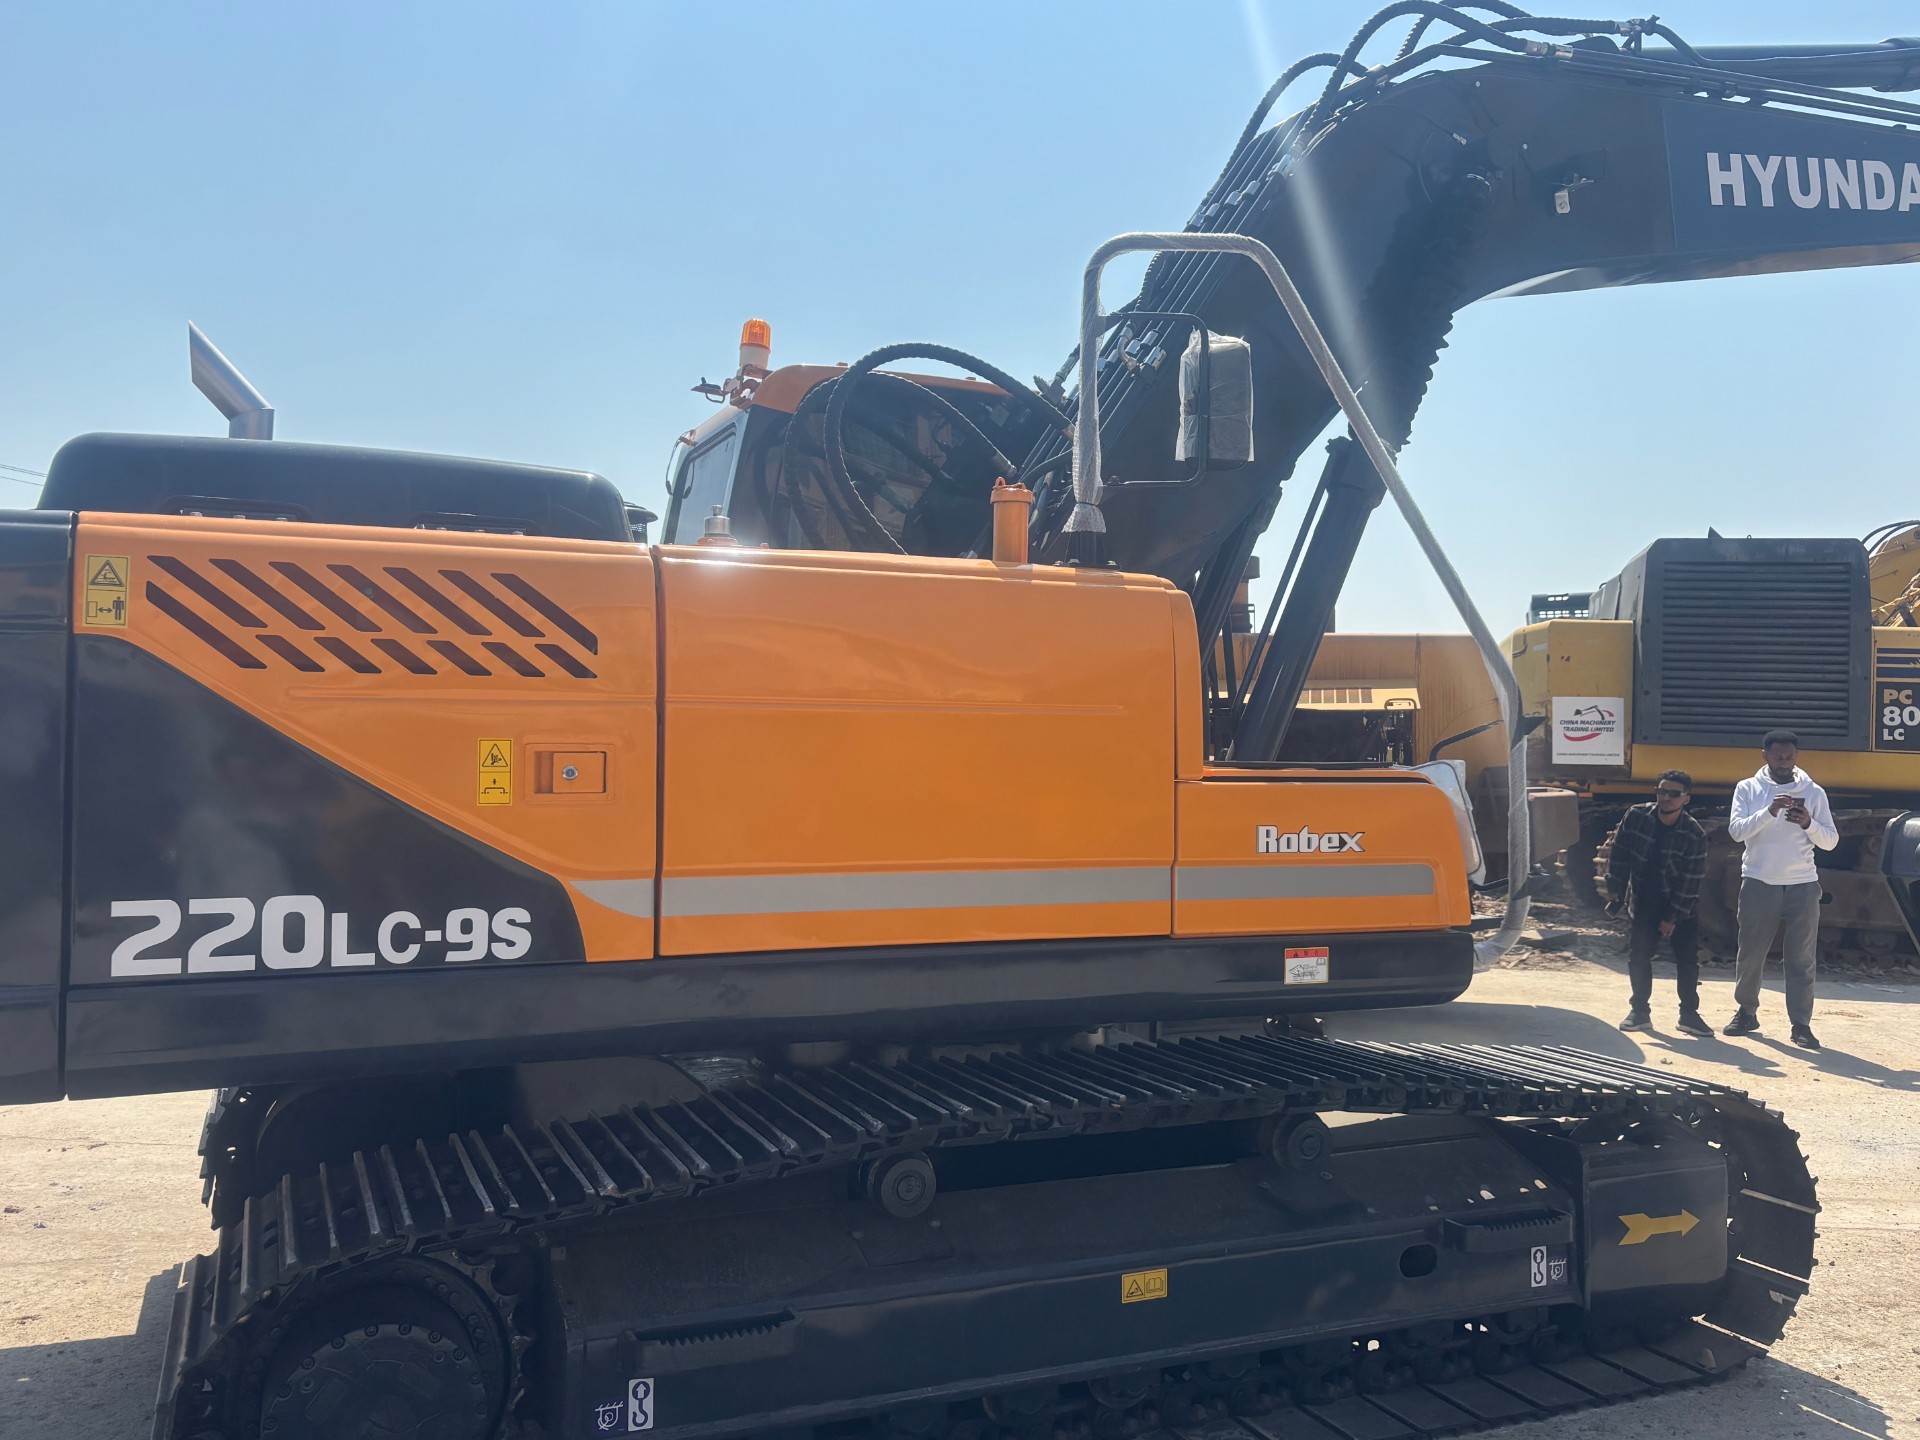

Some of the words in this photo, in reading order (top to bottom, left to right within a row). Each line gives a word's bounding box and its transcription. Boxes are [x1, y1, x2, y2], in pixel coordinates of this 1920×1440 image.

[1883, 688, 1913, 704] PC
[1882, 728, 1905, 741] LC
[1256, 824, 1366, 853] Robex
